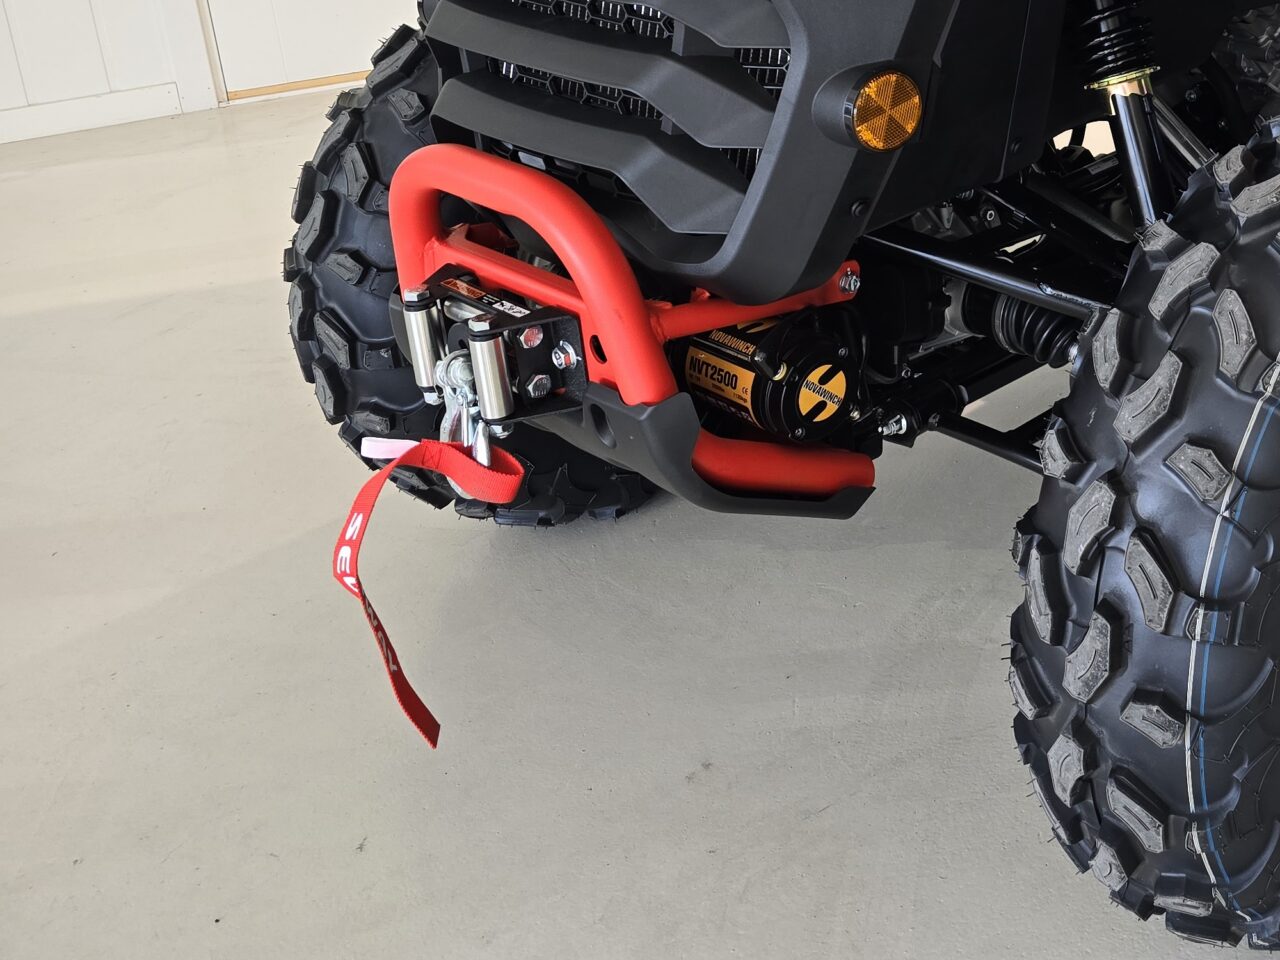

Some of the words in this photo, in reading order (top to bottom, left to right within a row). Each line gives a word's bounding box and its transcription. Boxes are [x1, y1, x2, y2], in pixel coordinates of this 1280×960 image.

[710, 329, 756, 355] NOVAWINCH
[689, 355, 738, 390] NVT2500
[803, 379, 843, 406] NOVAWINCH
